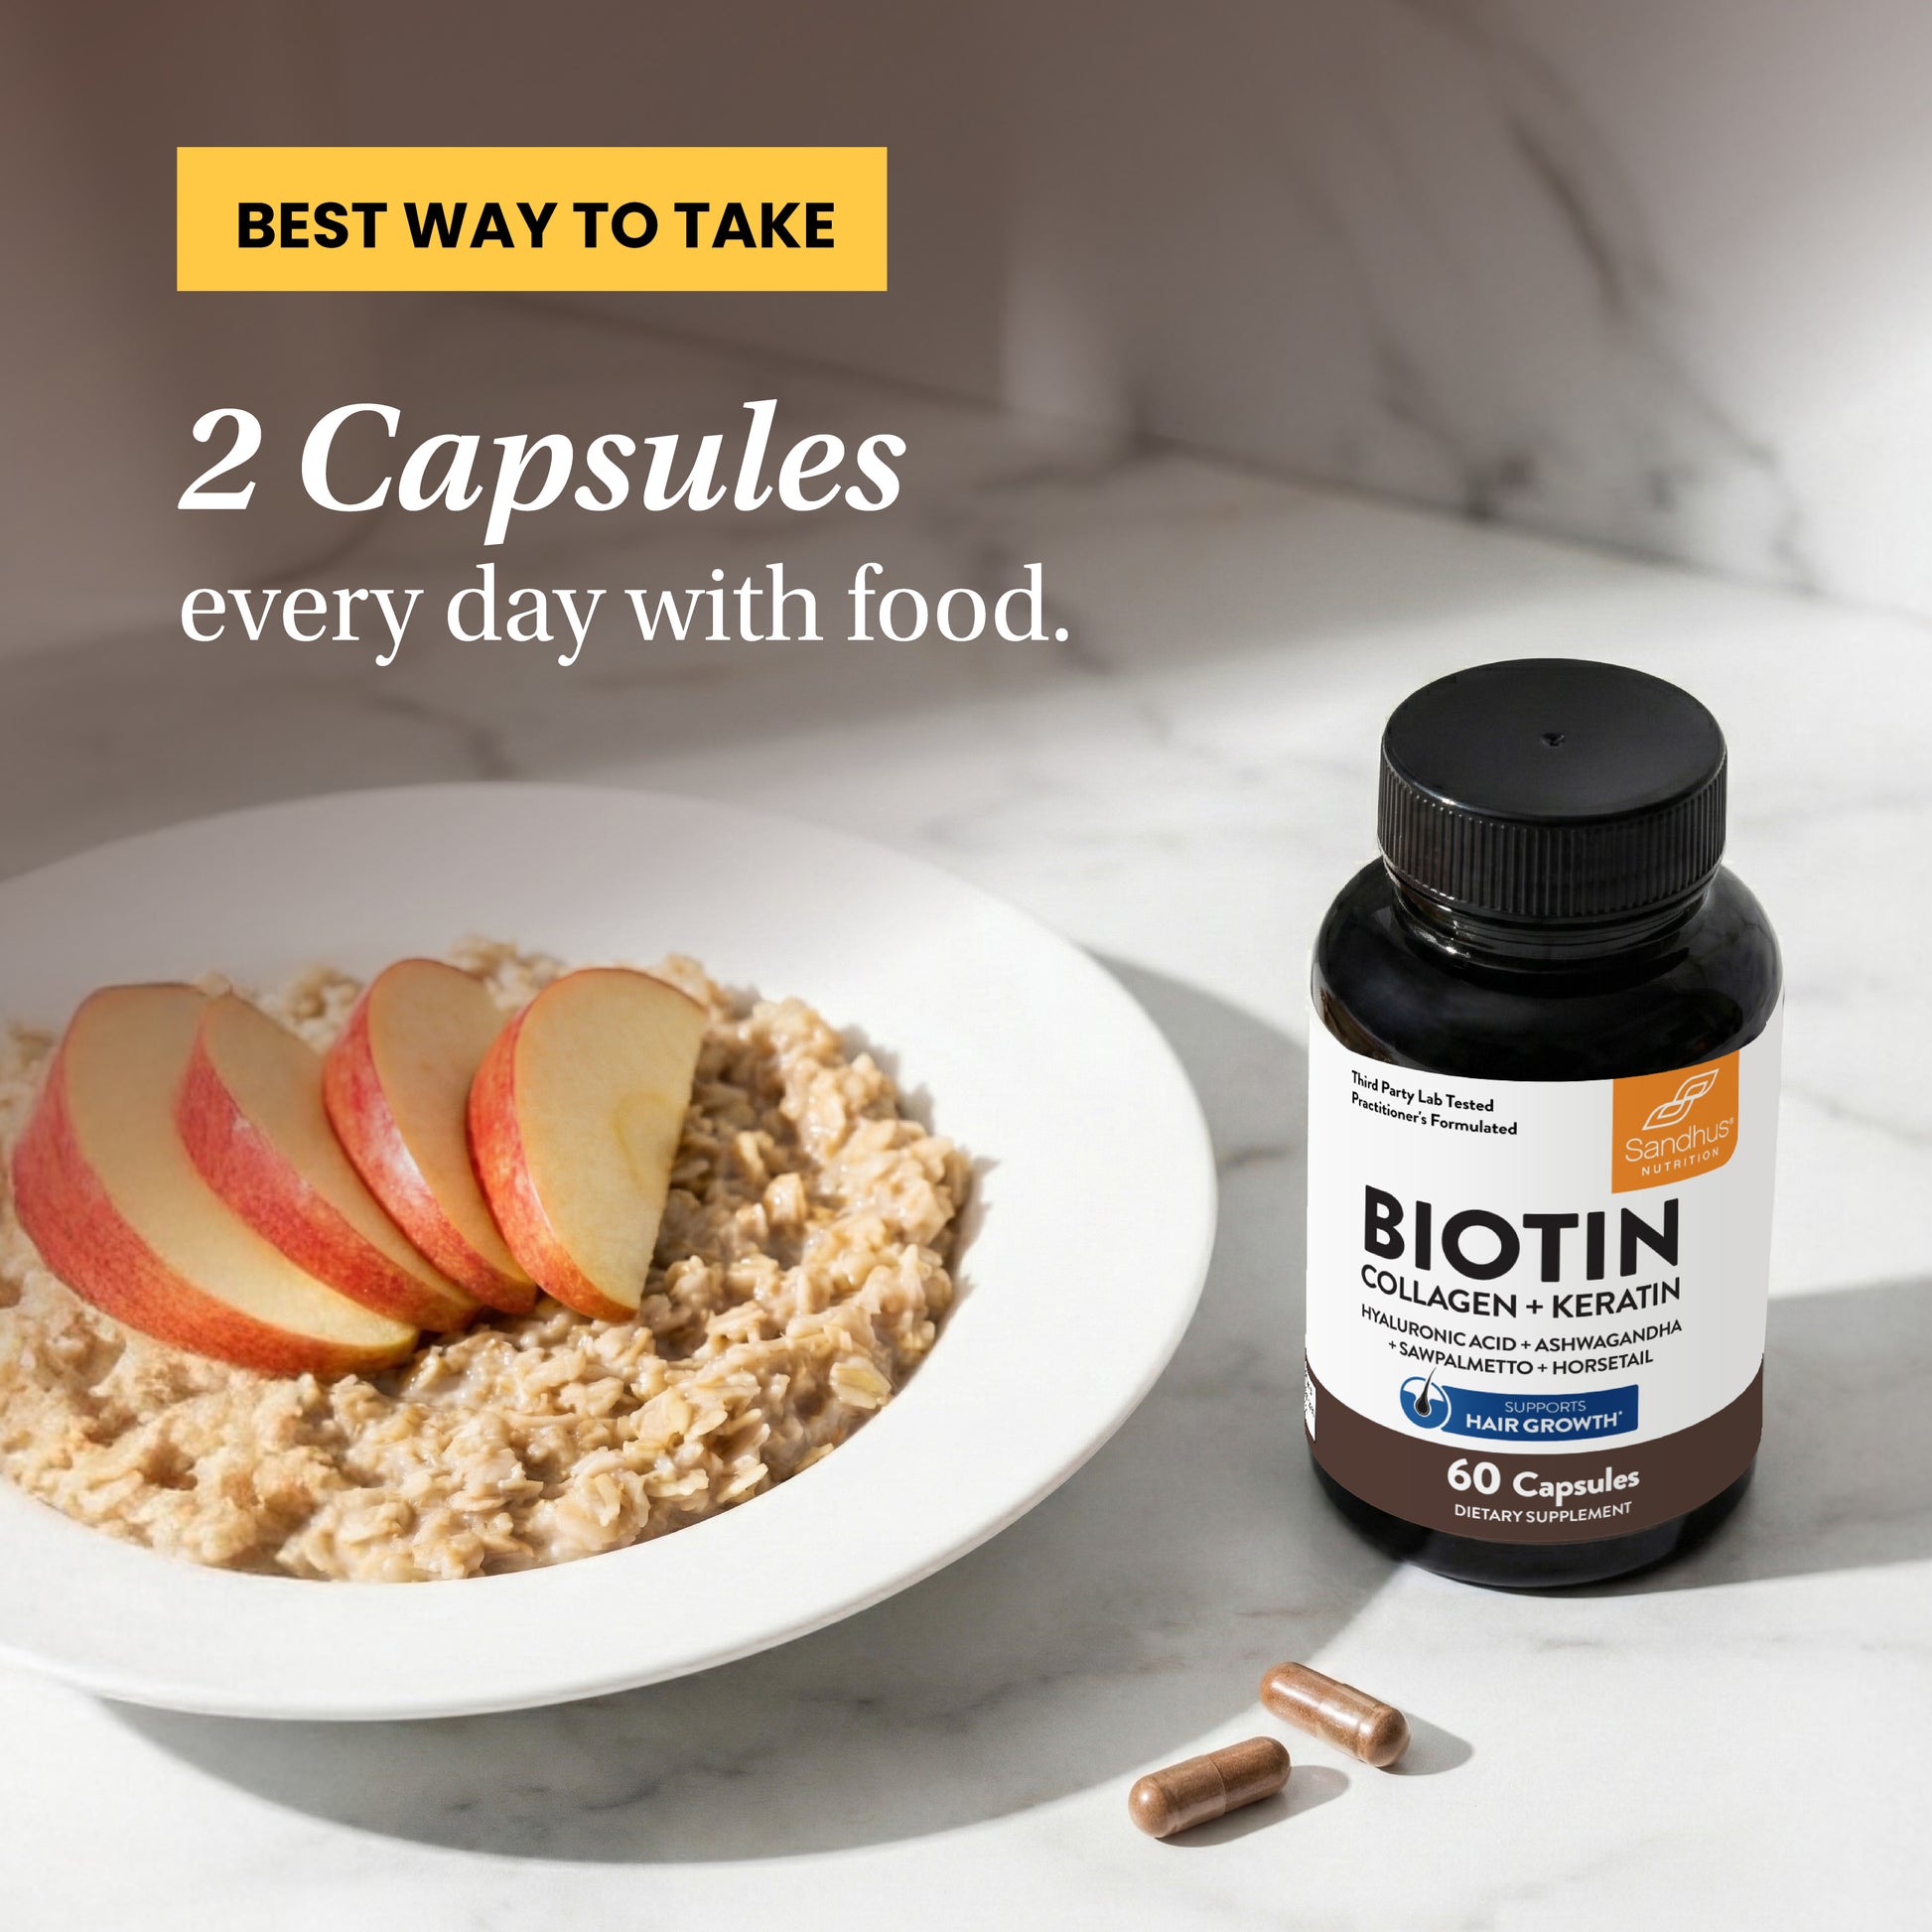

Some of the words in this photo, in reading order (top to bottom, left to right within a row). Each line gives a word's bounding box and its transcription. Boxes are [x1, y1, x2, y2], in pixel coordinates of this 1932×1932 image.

[1351, 1070, 1378, 1091] Third
[1381, 1080, 1415, 1105] Party
[1418, 1089, 1443, 1106] Lab
[1446, 1094, 1494, 1112] Tested
[1351, 1091, 1427, 1125] Practitioner's
[1431, 1113, 1518, 1135] Formulated
[1641, 1147, 1720, 1176] NUTRITION
[1364, 1184, 1679, 1283] BIOTIN
[1361, 1264, 1517, 1318] COLLAGEN
[1526, 1299, 1543, 1314] +
[1553, 1277, 1681, 1318] KERATIN
[1361, 1304, 1466, 1346] HYALURONIC
[1468, 1334, 1517, 1351] ACID
[1521, 1340, 1531, 1350] +
[1535, 1318, 1683, 1351] ASHWAGANDHA
[1388, 1340, 1397, 1349] +
[1399, 1341, 1533, 1374] SAWPALMETTO
[1537, 1363, 1548, 1372] +
[1553, 1349, 1654, 1375] HORSETAIL
[1465, 1413, 1519, 1433] HAIR
[1504, 1400, 1587, 1414] SUPPORTS
[1447, 1457, 1501, 1495] 60
[1512, 1466, 1640, 1507] Capsules
[1454, 1504, 1523, 1523] DIETARY
[1526, 1501, 1632, 1523] SUPPLEMENT
